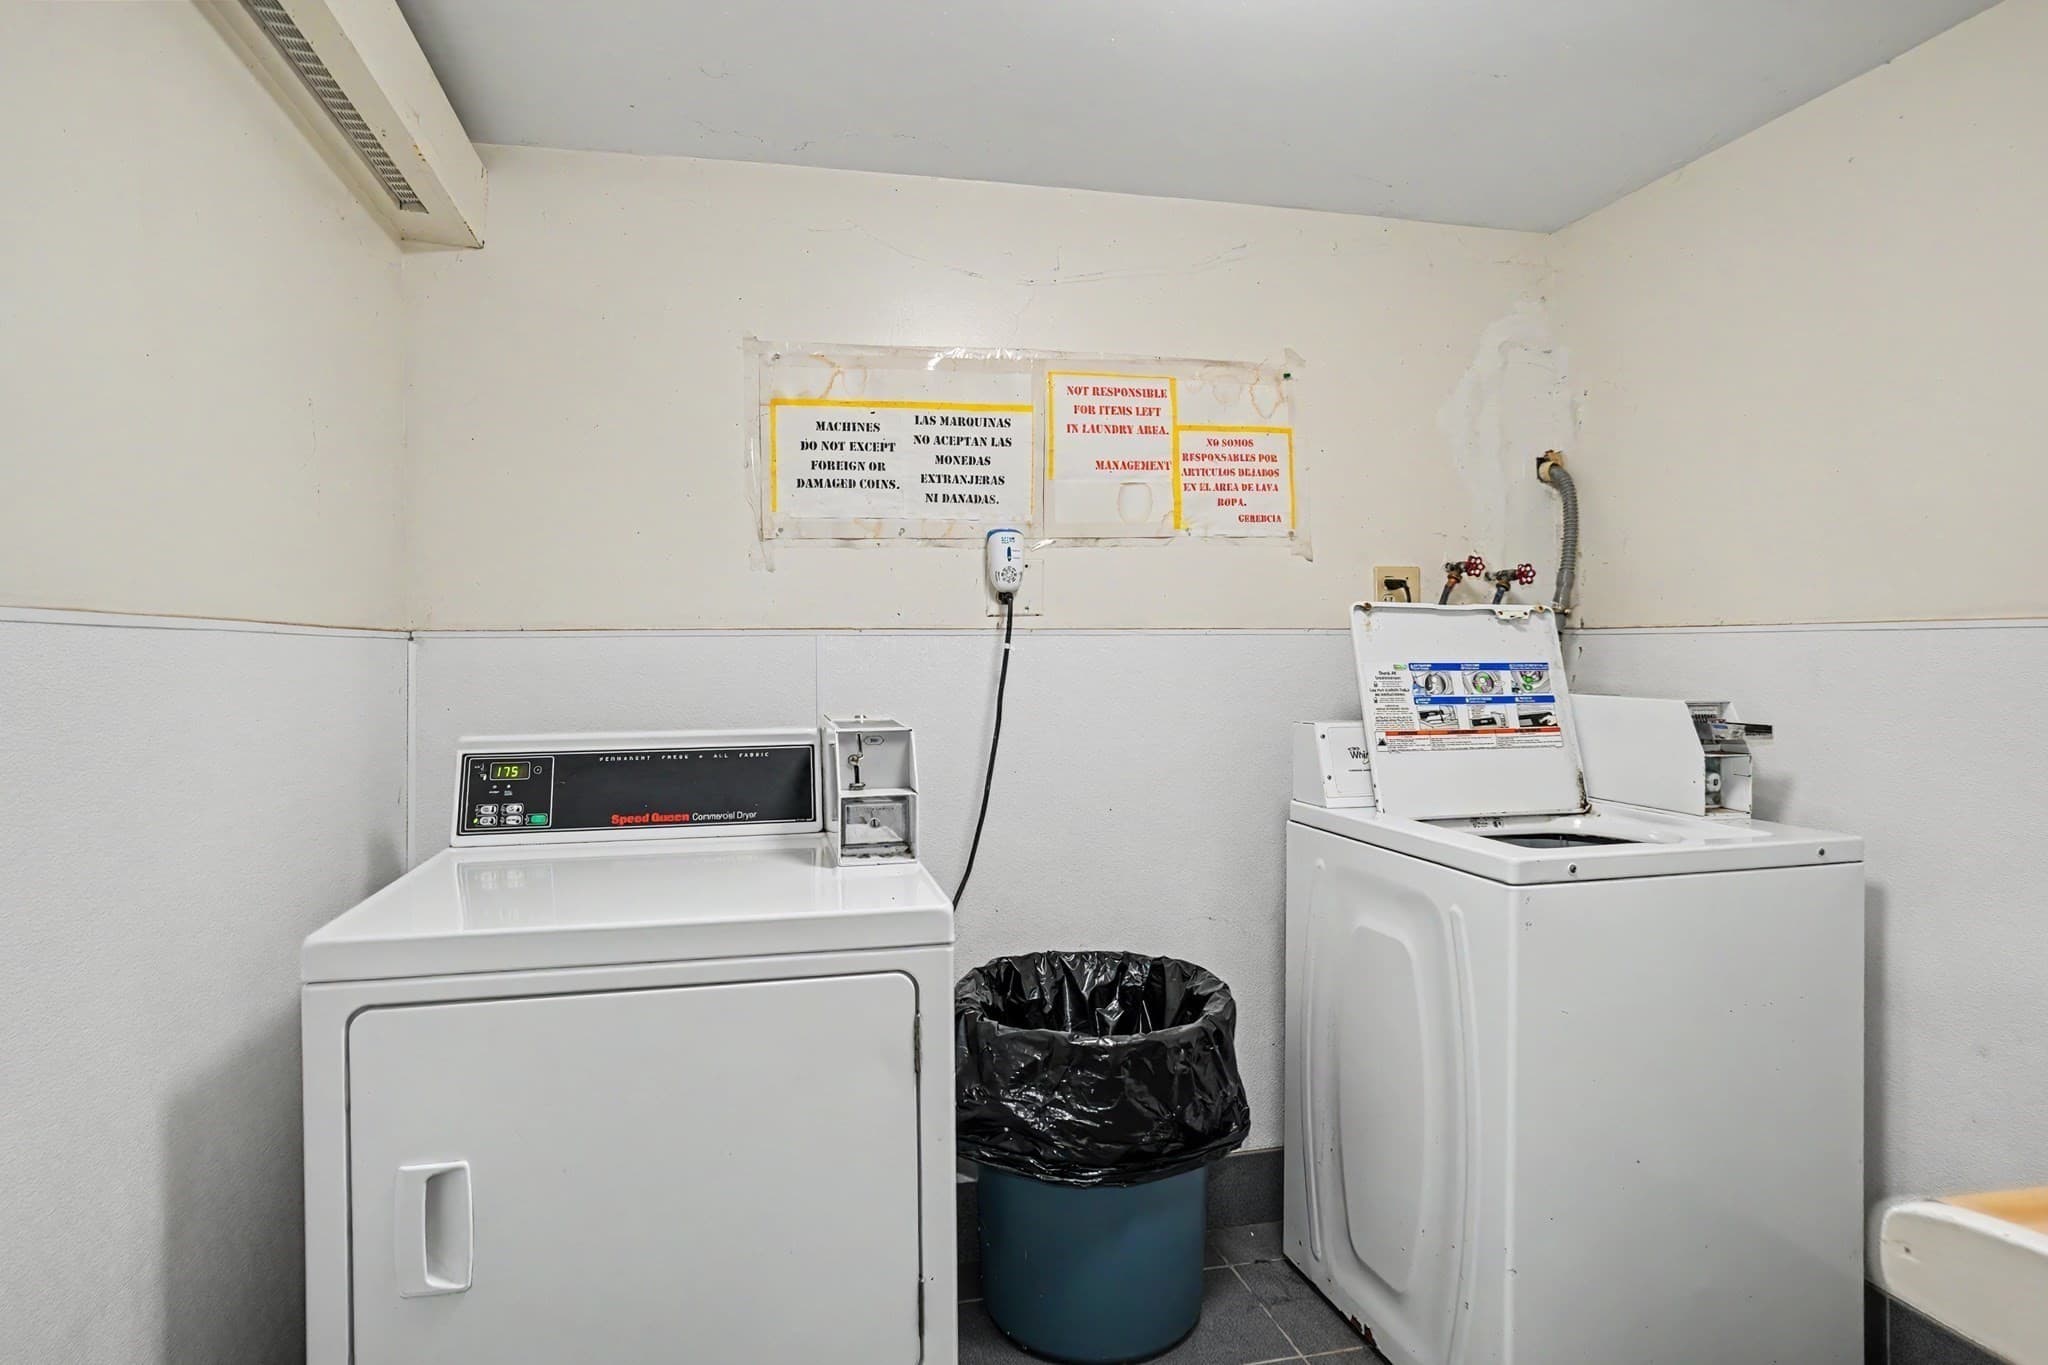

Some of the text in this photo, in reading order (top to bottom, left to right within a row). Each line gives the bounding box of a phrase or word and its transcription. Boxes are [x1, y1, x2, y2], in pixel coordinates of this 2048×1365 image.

[1067, 386, 1167, 398] NOT RESPONSIBLE
[1074, 405, 1162, 416] FOR ITEMS LEFT
[816, 421, 881, 433] MACHINES
[914, 415, 1011, 428] LAS MARQUINAS
[1066, 424, 1169, 435] IN LAUNDRY AREA.
[800, 441, 896, 452] DO NOT EXCEPT
[913, 435, 1012, 447] NO ACEPTAN LAS
[1207, 439, 1254, 447] NO SOMOS
[935, 455, 991, 466] MONEDAS
[1182, 453, 1278, 462] RESPONSABLES POR
[811, 460, 886, 471] FOREIGN OR
[1096, 460, 1172, 471] MANAGEMENT
[1182, 468, 1280, 477] ARTICULOS DEJADOS
[796, 478, 900, 490] DAMAGED COINS.
[920, 474, 1006, 485] EXTRANJERAS
[1183, 483, 1279, 492] EN EL AREA DE LAVA
[925, 493, 938, 503] NI
[1217, 498, 1247, 506] ROPA.
[496, 765, 519, 778] 175
[651, 812, 689, 822] Queen
[692, 811, 735, 821] Commercial
[737, 811, 757, 820] Dryer
